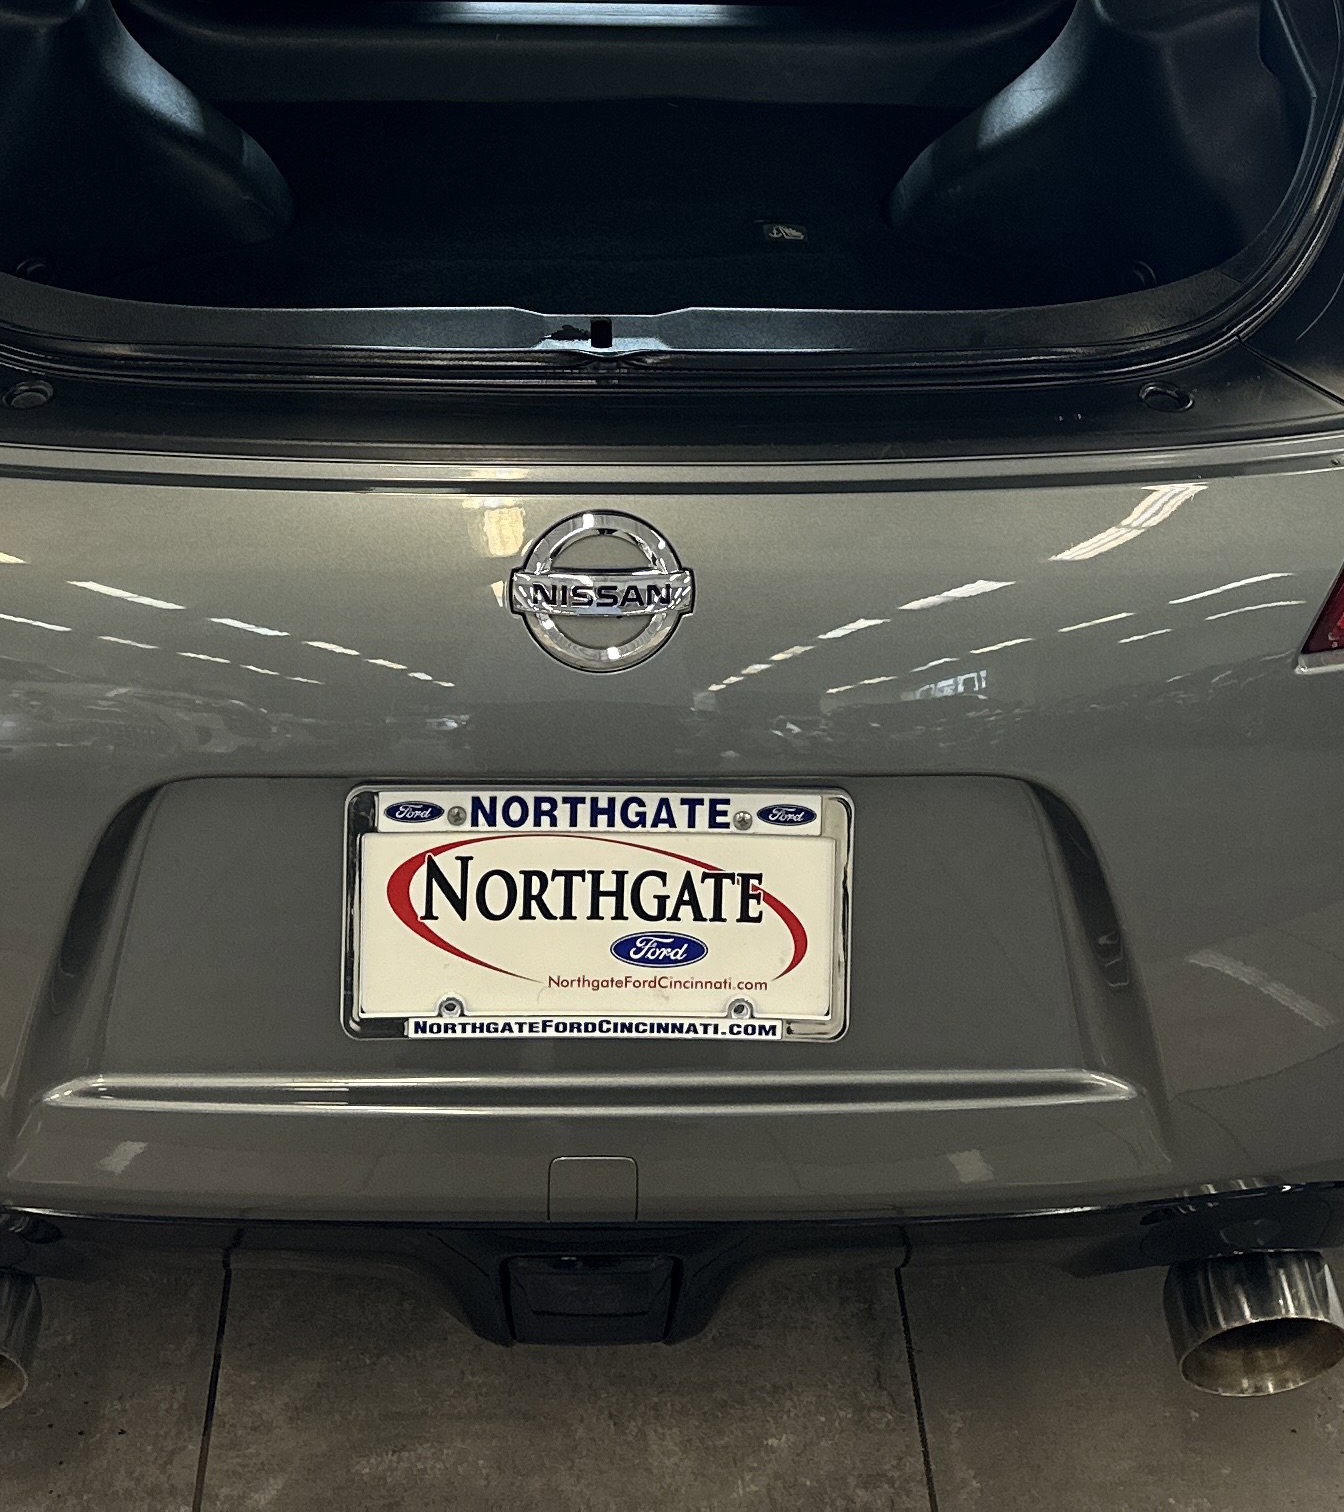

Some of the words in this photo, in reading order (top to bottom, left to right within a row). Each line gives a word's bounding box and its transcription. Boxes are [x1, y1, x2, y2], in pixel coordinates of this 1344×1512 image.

[531, 582, 672, 608] NISSAN
[470, 796, 731, 829] NORTHGATE
[629, 935, 689, 963] Ford
[547, 975, 769, 992] NorthgateFordCincinnati.com
